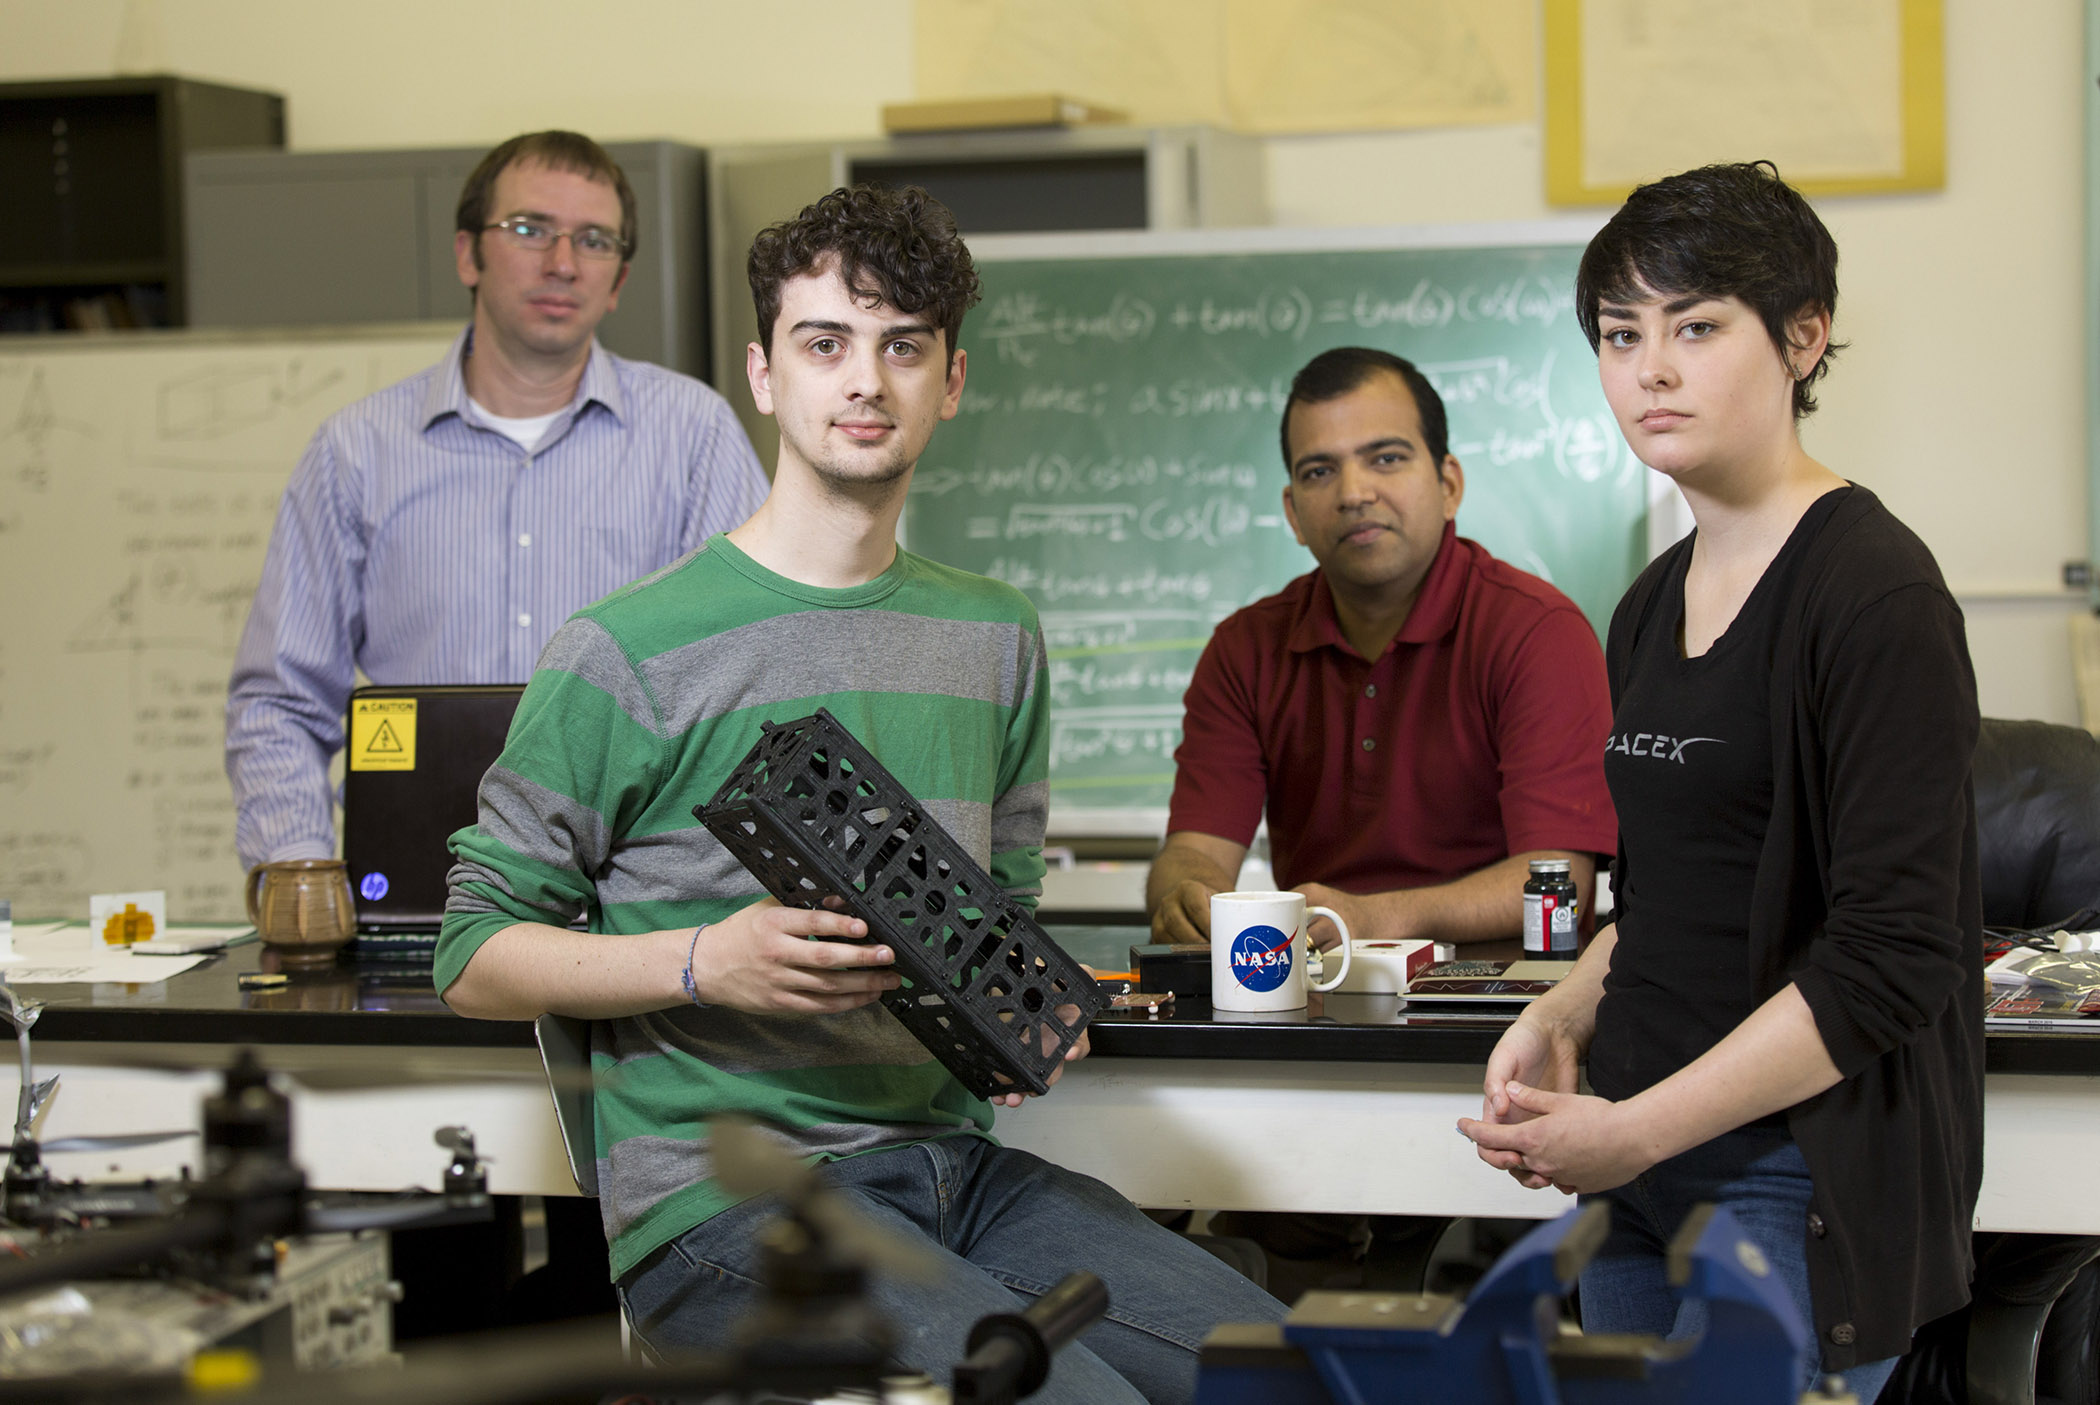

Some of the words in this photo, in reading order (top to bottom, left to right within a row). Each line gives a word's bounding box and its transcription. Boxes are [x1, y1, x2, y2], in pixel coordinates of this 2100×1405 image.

[370, 703, 414, 713] CAUTION
[361, 872, 389, 901] hp
[1234, 951, 1290, 967] NASA
